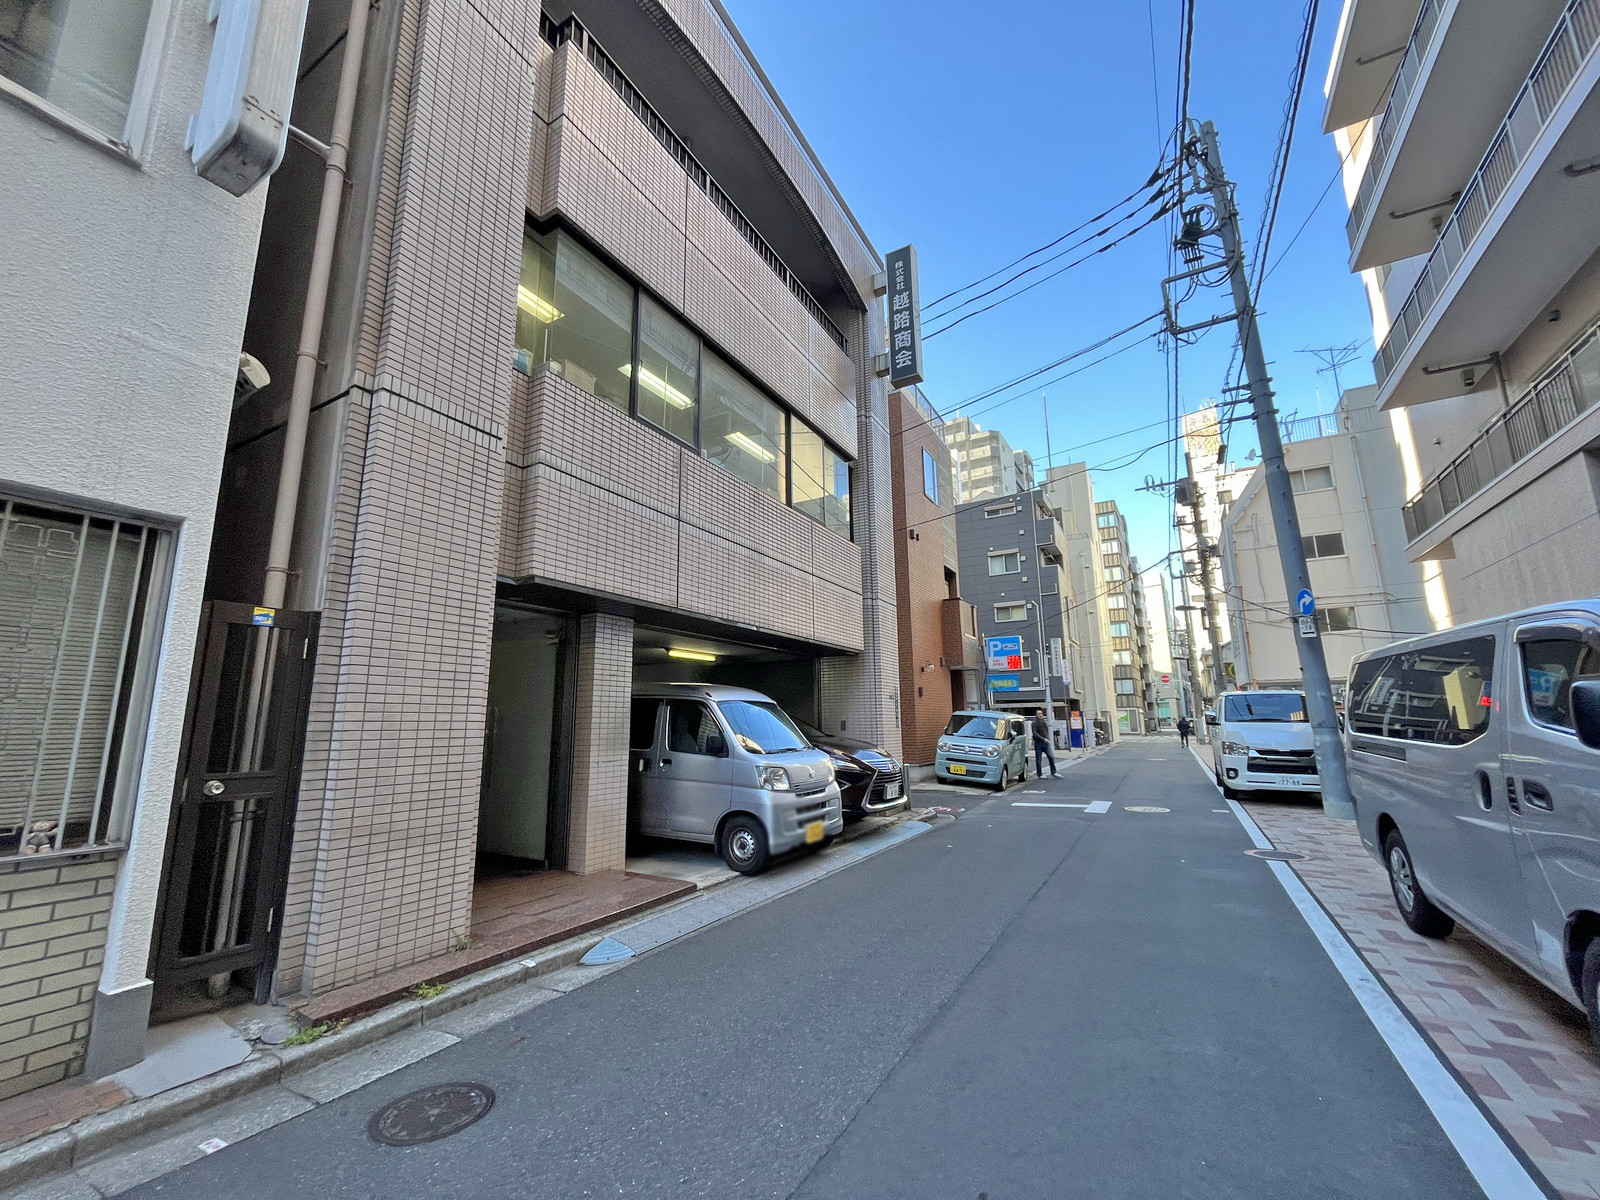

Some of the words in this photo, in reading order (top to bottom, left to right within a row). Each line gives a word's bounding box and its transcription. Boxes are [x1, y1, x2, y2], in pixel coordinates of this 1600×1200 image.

[894, 261, 904, 290] 株式会社
[893, 291, 912, 368] 越路商会
[989, 641, 1001, 657] P
